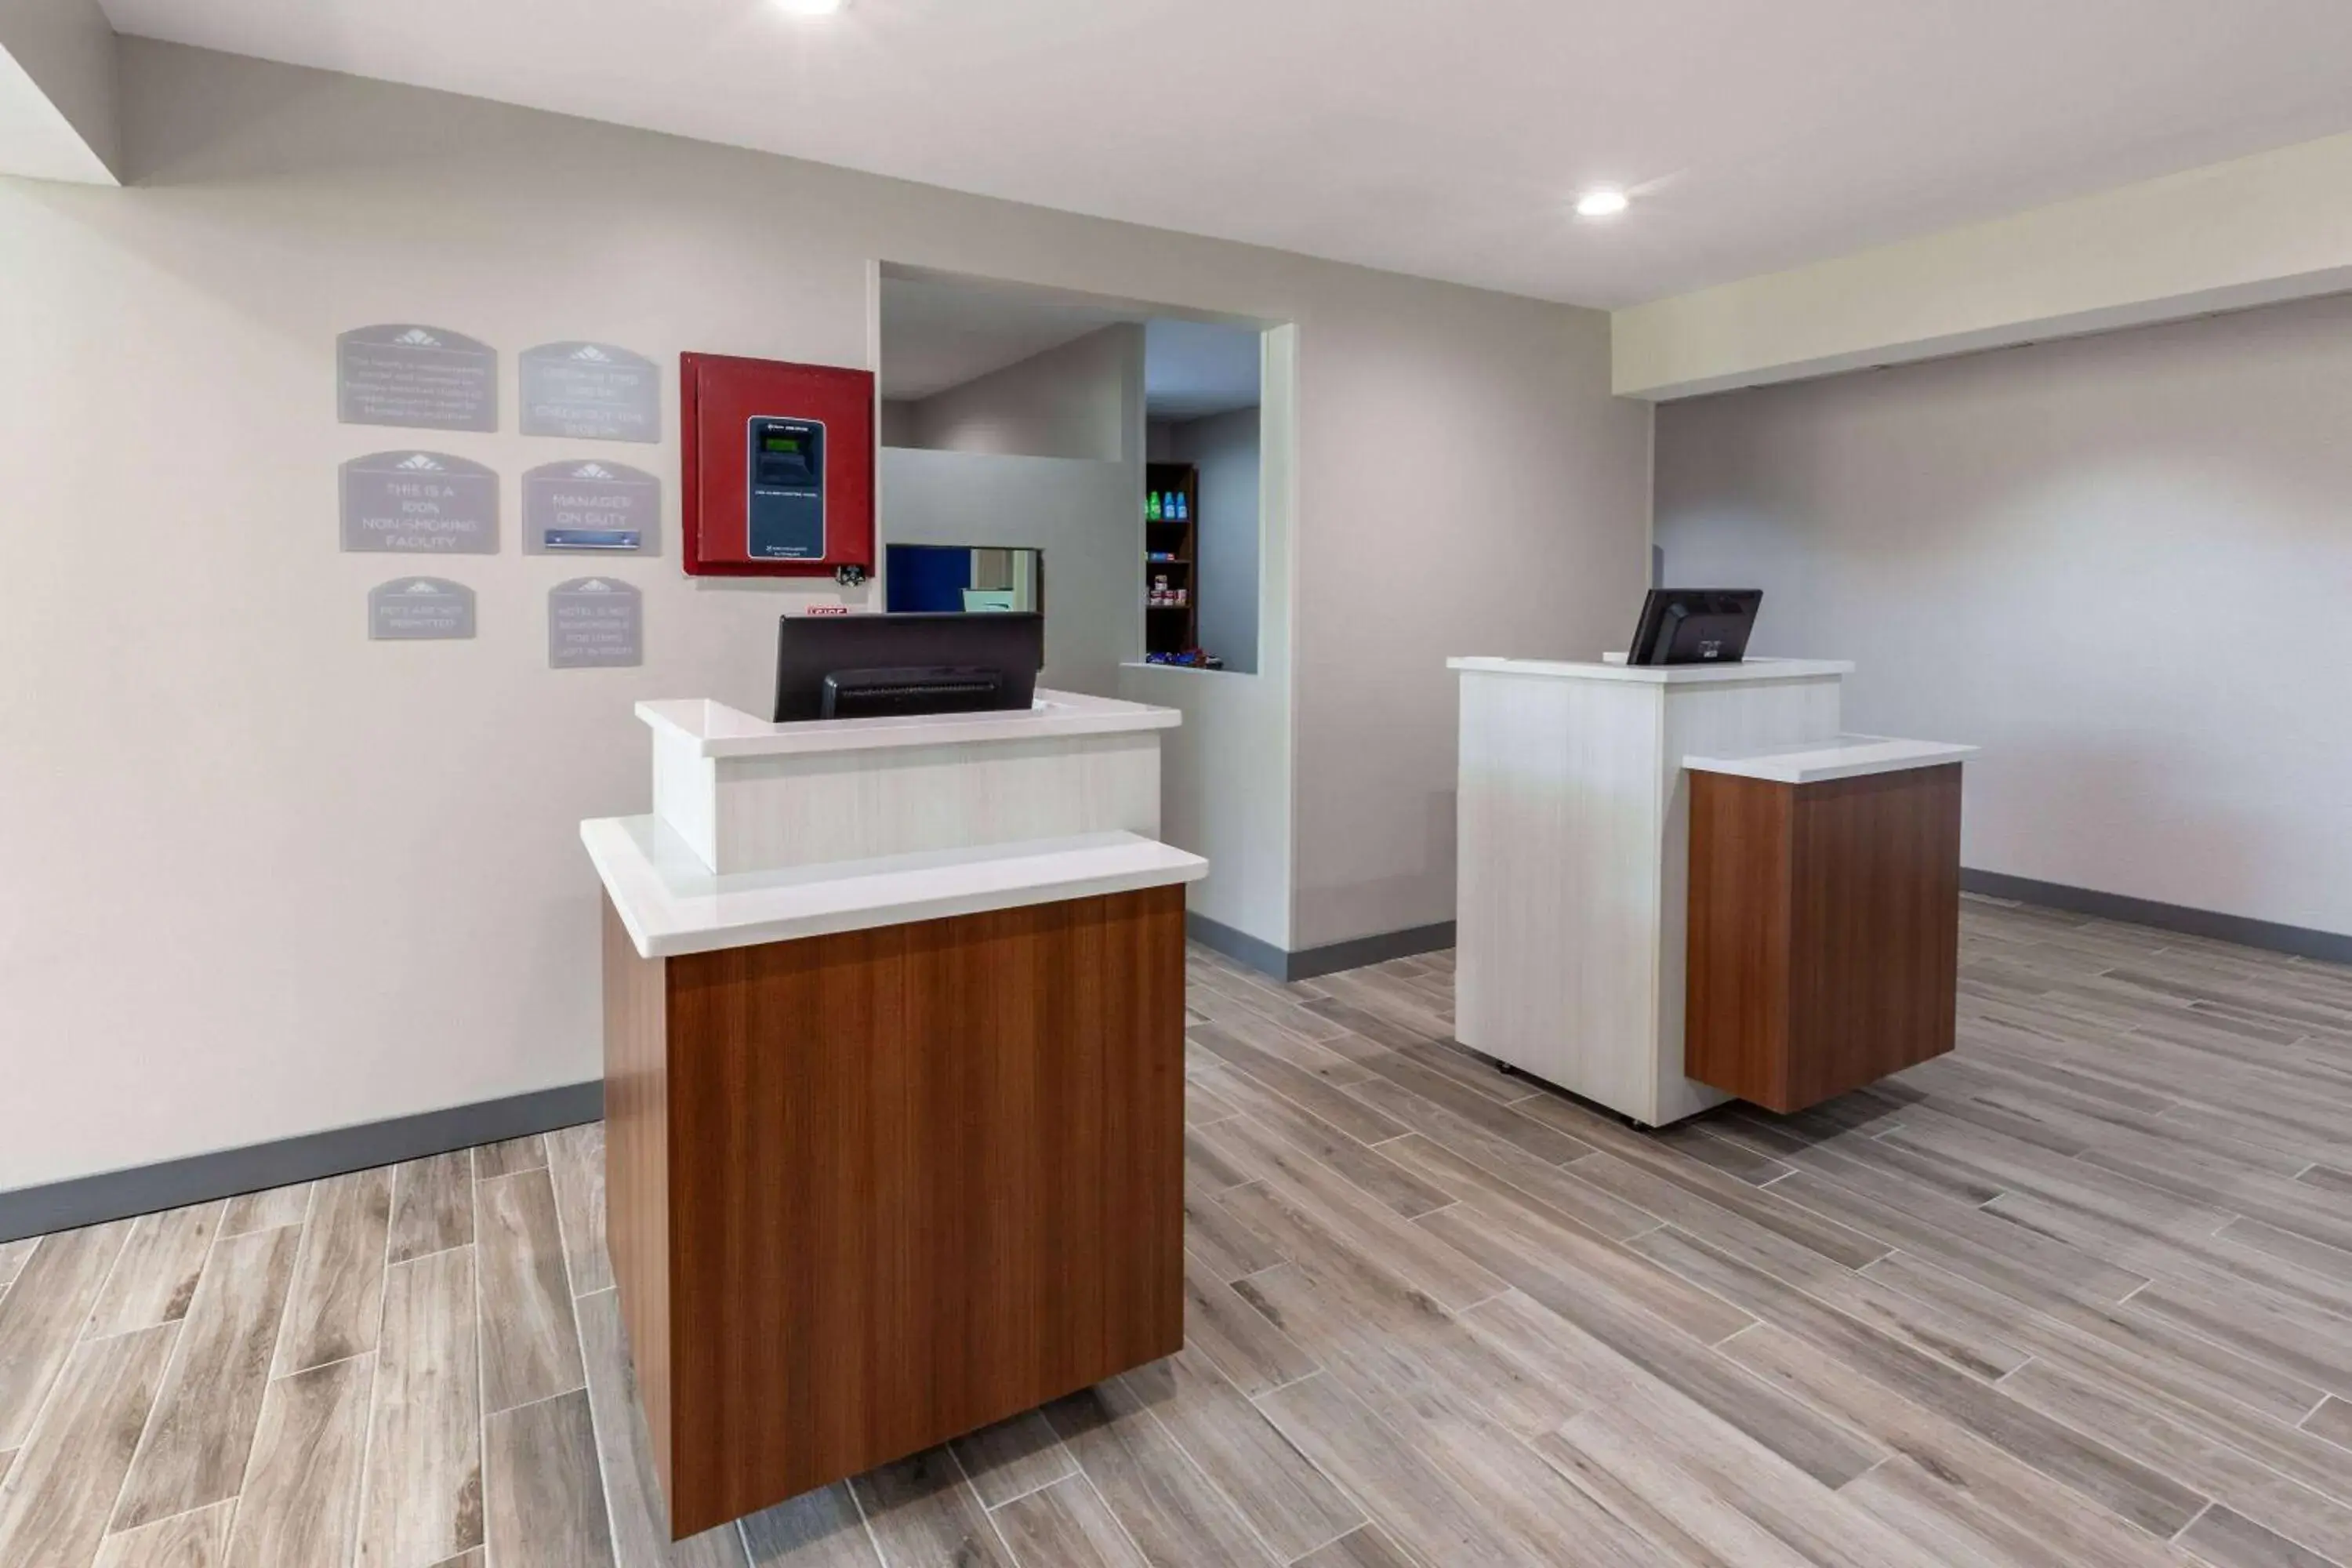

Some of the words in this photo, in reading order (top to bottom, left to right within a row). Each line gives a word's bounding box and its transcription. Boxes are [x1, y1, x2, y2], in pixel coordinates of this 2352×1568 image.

[387, 482, 421, 497] THIS
[442, 485, 455, 497] A
[553, 494, 632, 509] MANAGER
[362, 517, 479, 532] NON-SMOKING
[557, 511, 581, 524] ON
[386, 534, 456, 547] FACILITY
